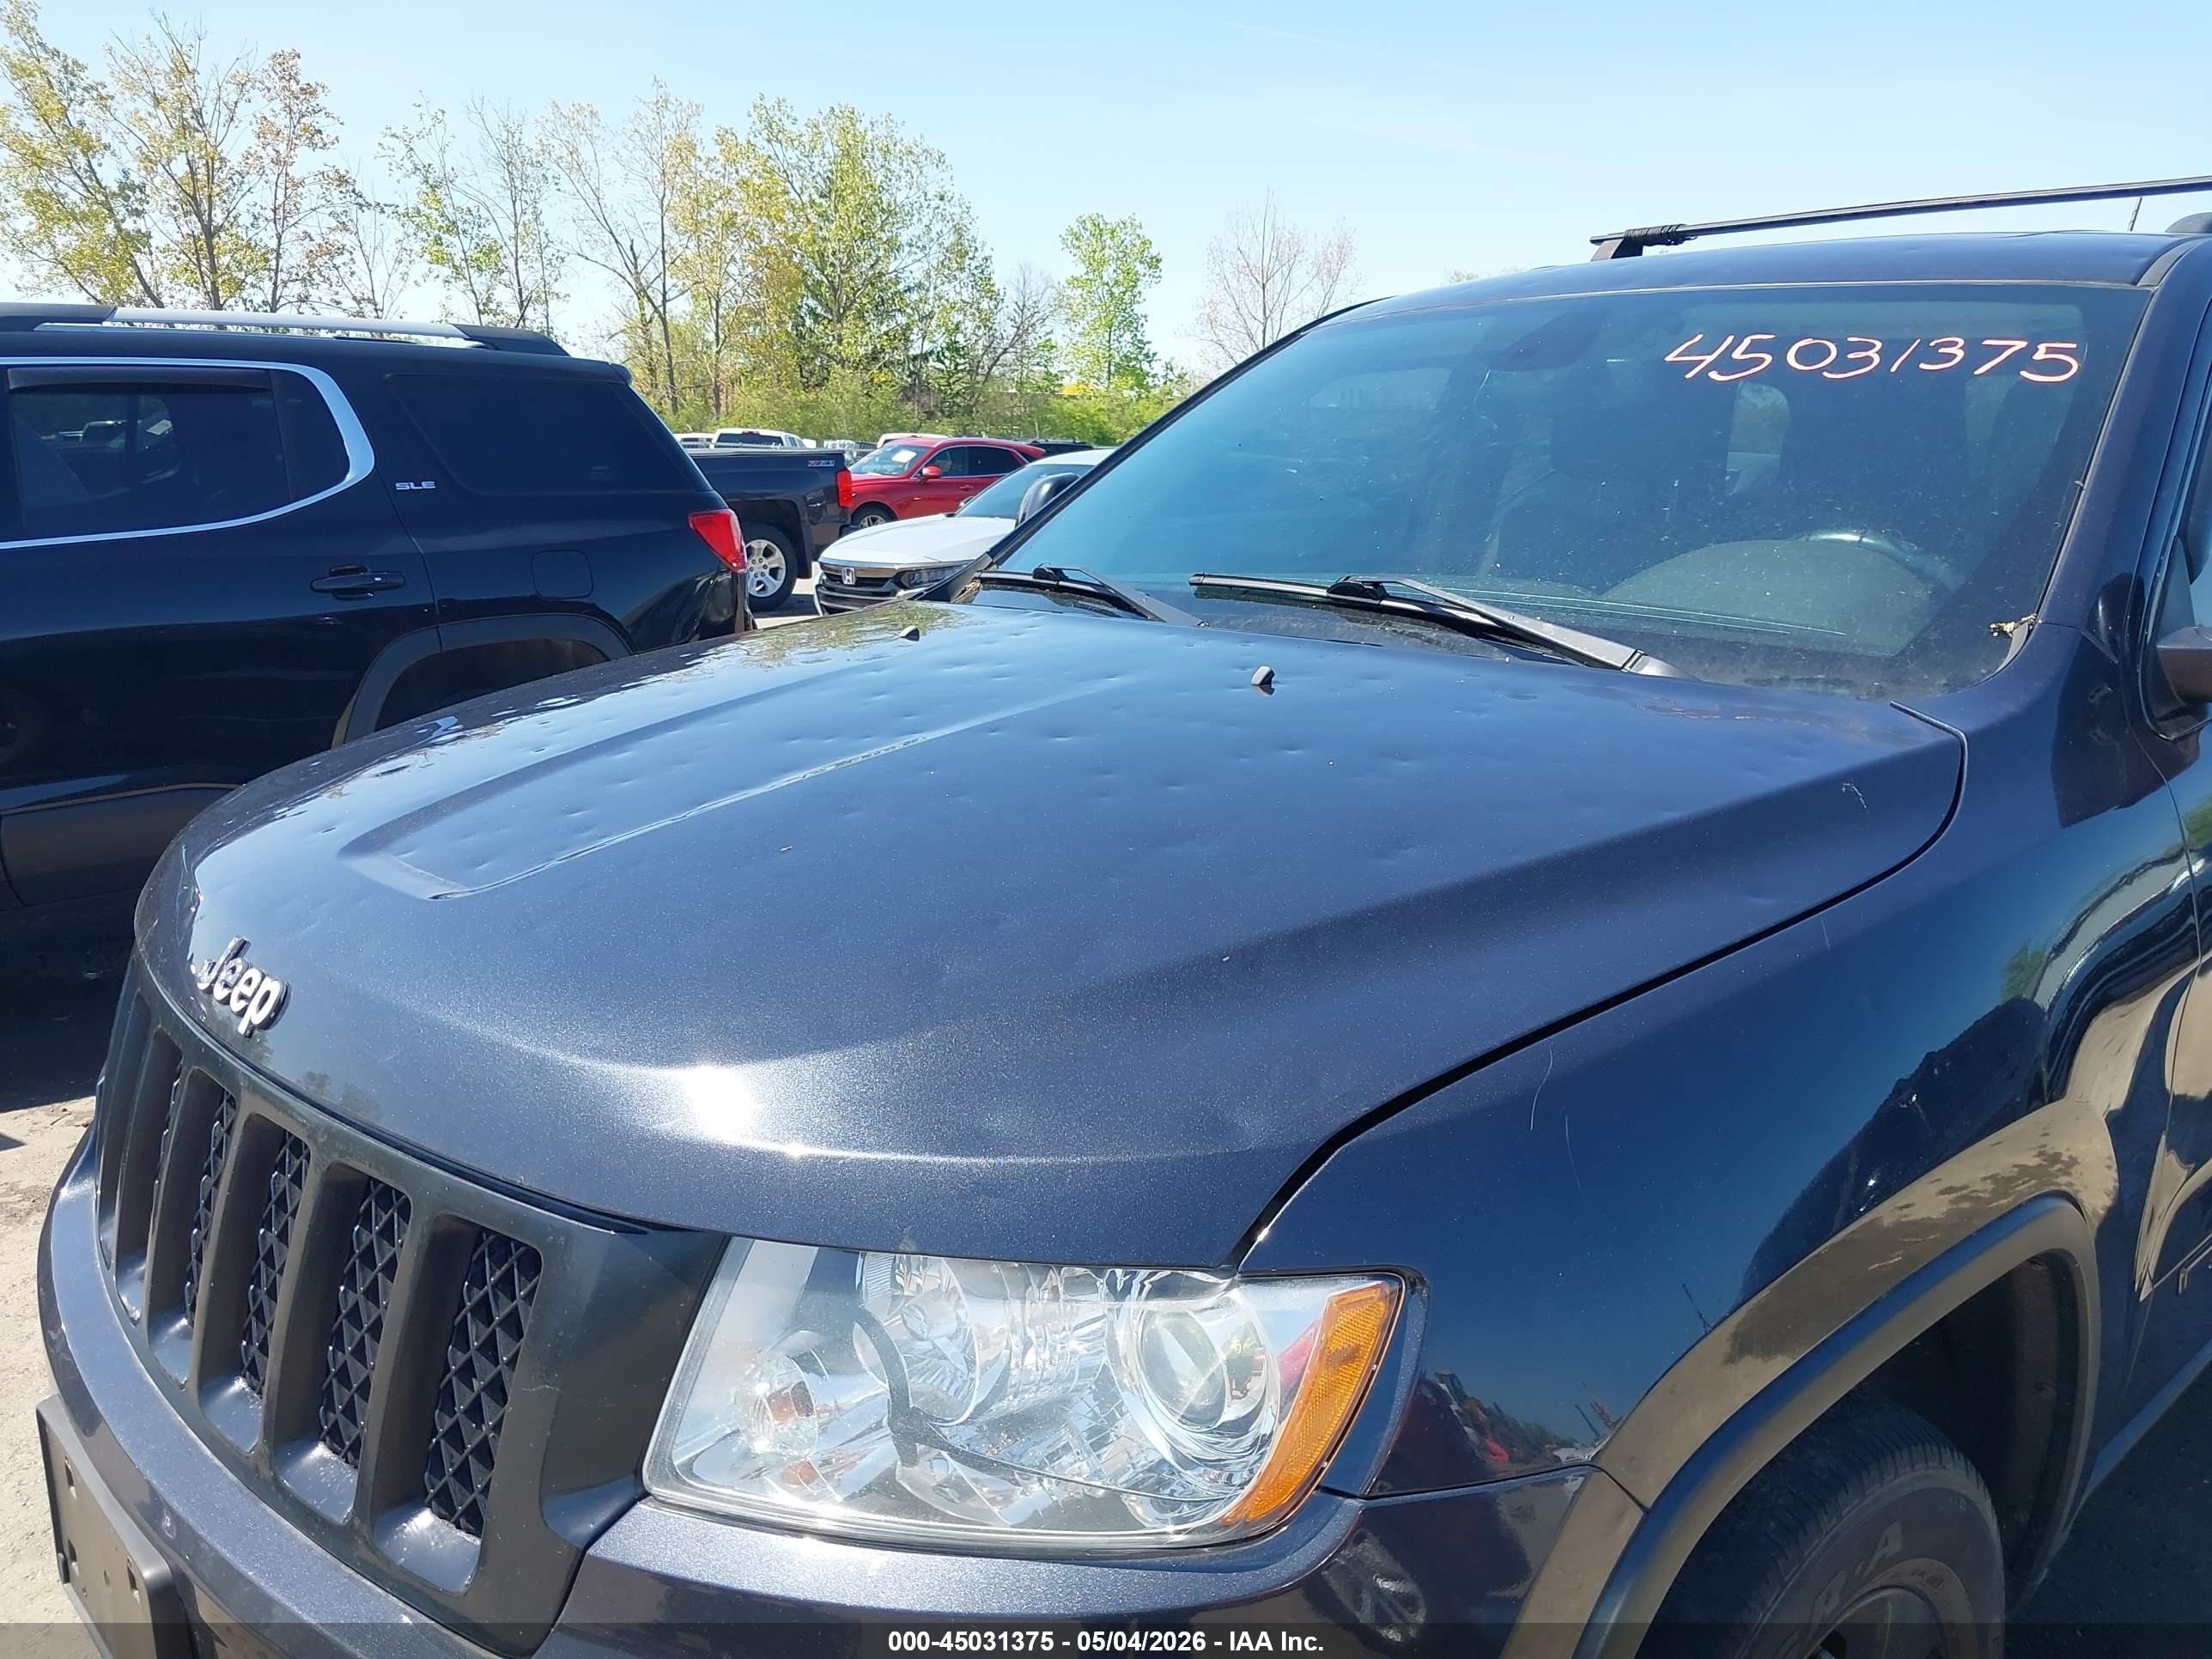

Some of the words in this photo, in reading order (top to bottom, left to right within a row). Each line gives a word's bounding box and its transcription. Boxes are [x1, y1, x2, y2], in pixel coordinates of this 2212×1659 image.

[1664, 333, 2081, 383] 45031375
[395, 481, 436, 490] SLE
[196, 936, 292, 1038] Jeep
